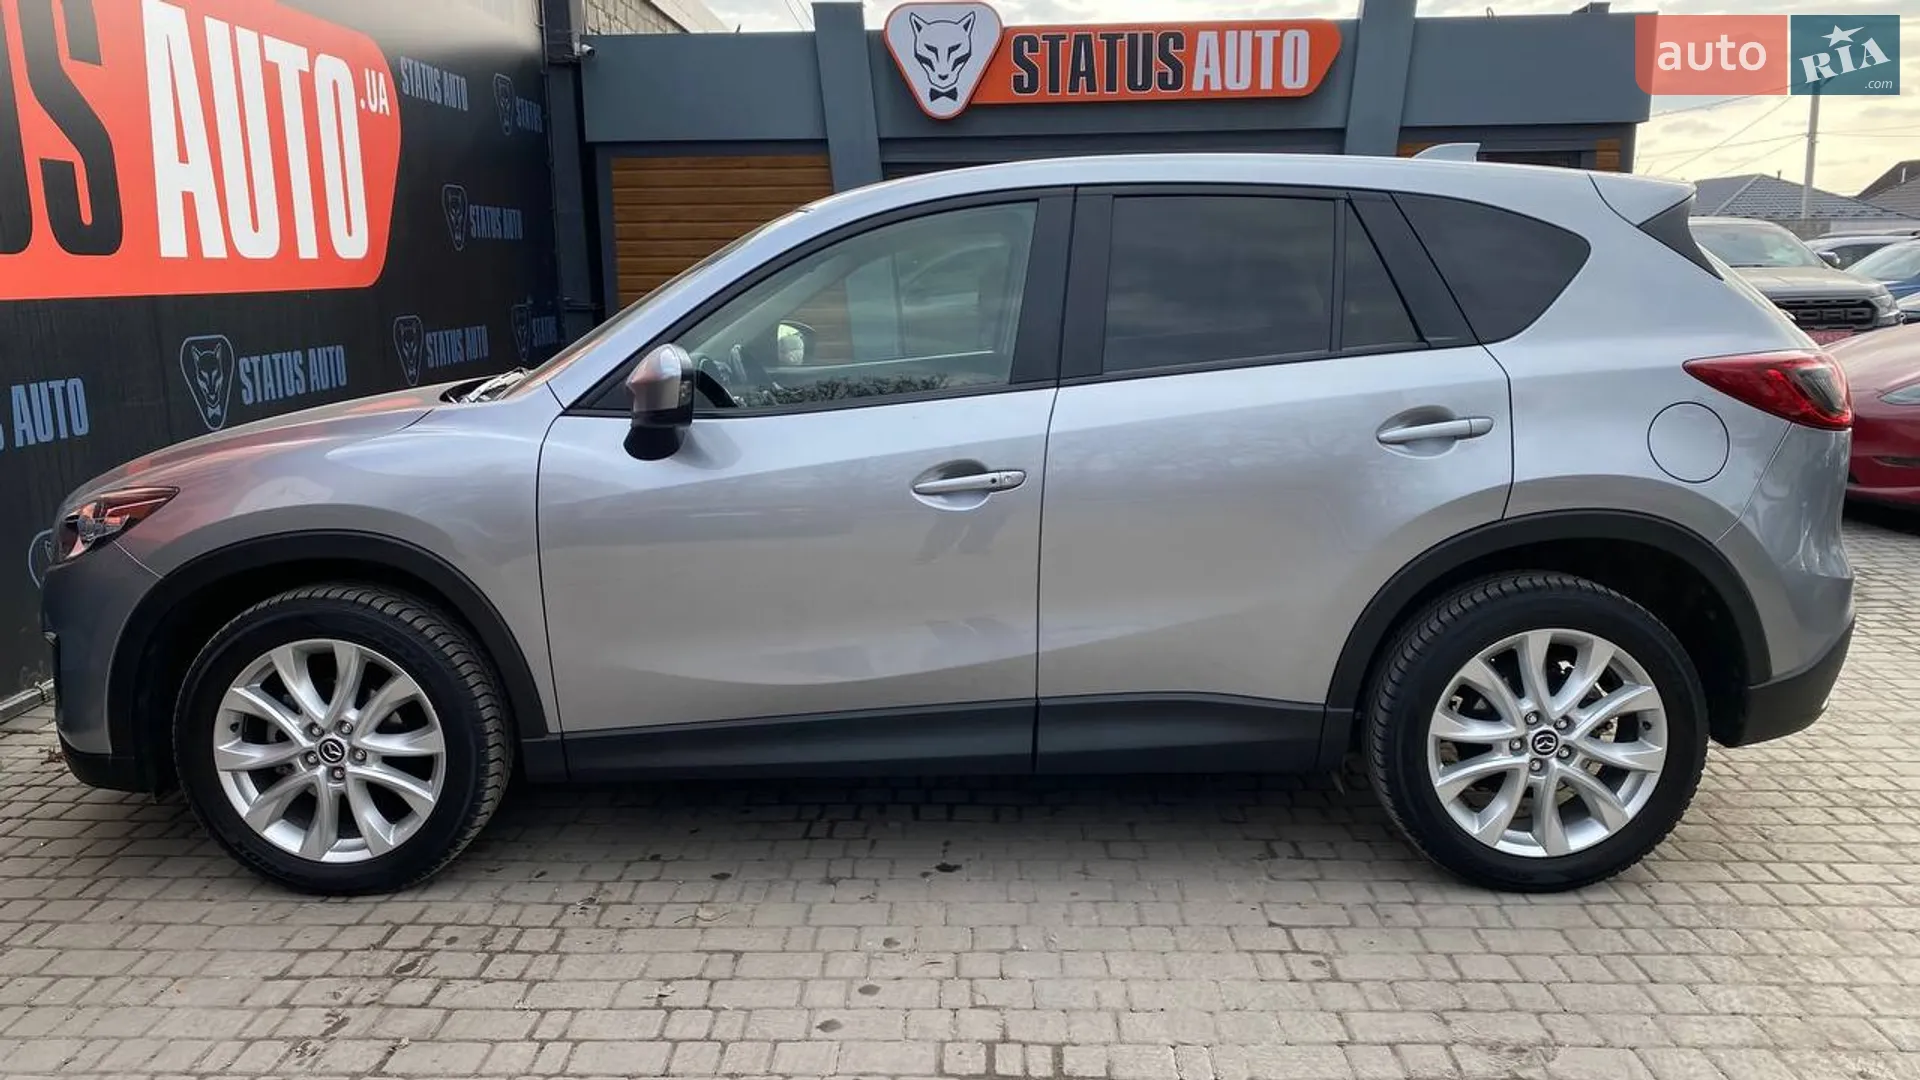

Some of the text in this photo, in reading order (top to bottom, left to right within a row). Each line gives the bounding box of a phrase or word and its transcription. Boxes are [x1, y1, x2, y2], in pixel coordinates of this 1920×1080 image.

[400, 56, 468, 112] STATUS AUTO
[1011, 28, 1310, 95] STATUS AUTO
[142, 0, 369, 260] AUTO
[469, 204, 524, 240] STATUS AUTO
[239, 345, 348, 405] STATUS AUTO
[425, 324, 489, 369] STATUS AUTO
[11, 378, 89, 447] AUTO
